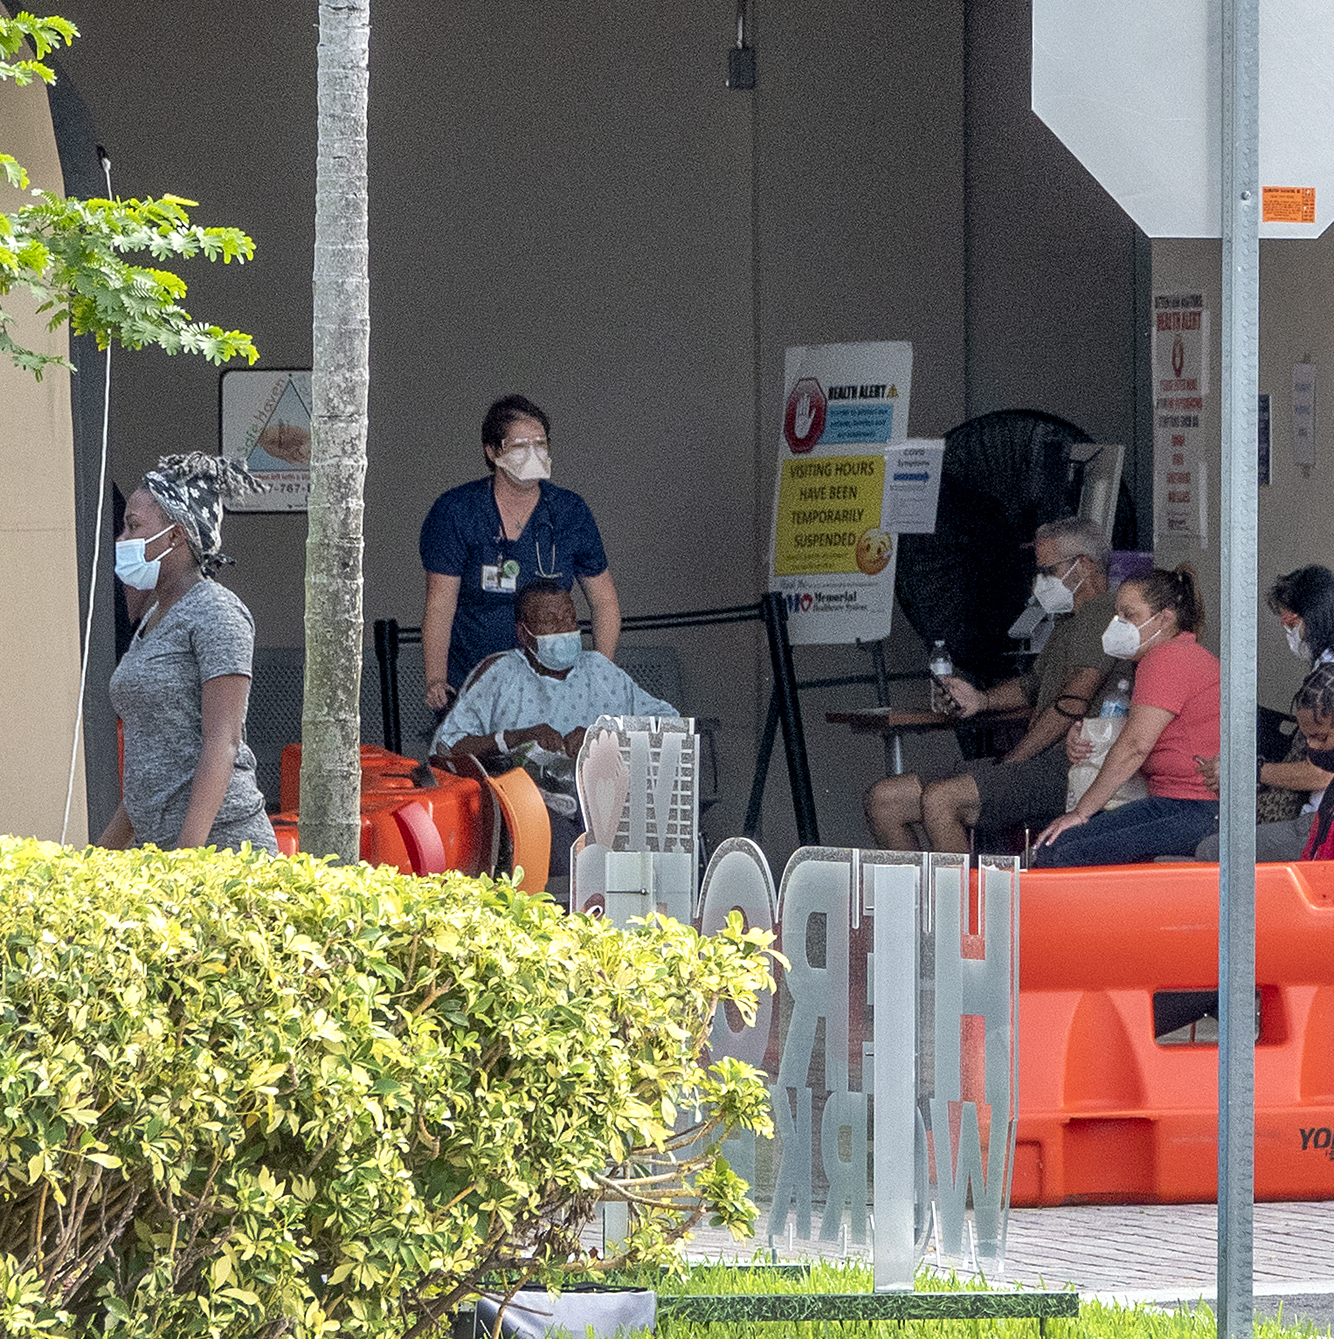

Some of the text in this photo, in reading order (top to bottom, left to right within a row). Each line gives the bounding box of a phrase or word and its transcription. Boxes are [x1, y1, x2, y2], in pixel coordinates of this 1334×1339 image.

[828, 383, 887, 400] HEALTH ALERT
[254, 377, 286, 424] Haven
[789, 461, 875, 479] VISITING HOURS
[799, 485, 858, 501] HAVE BEEN
[791, 508, 865, 526] TEMPORARILY
[793, 532, 857, 549] SUSPENDED
